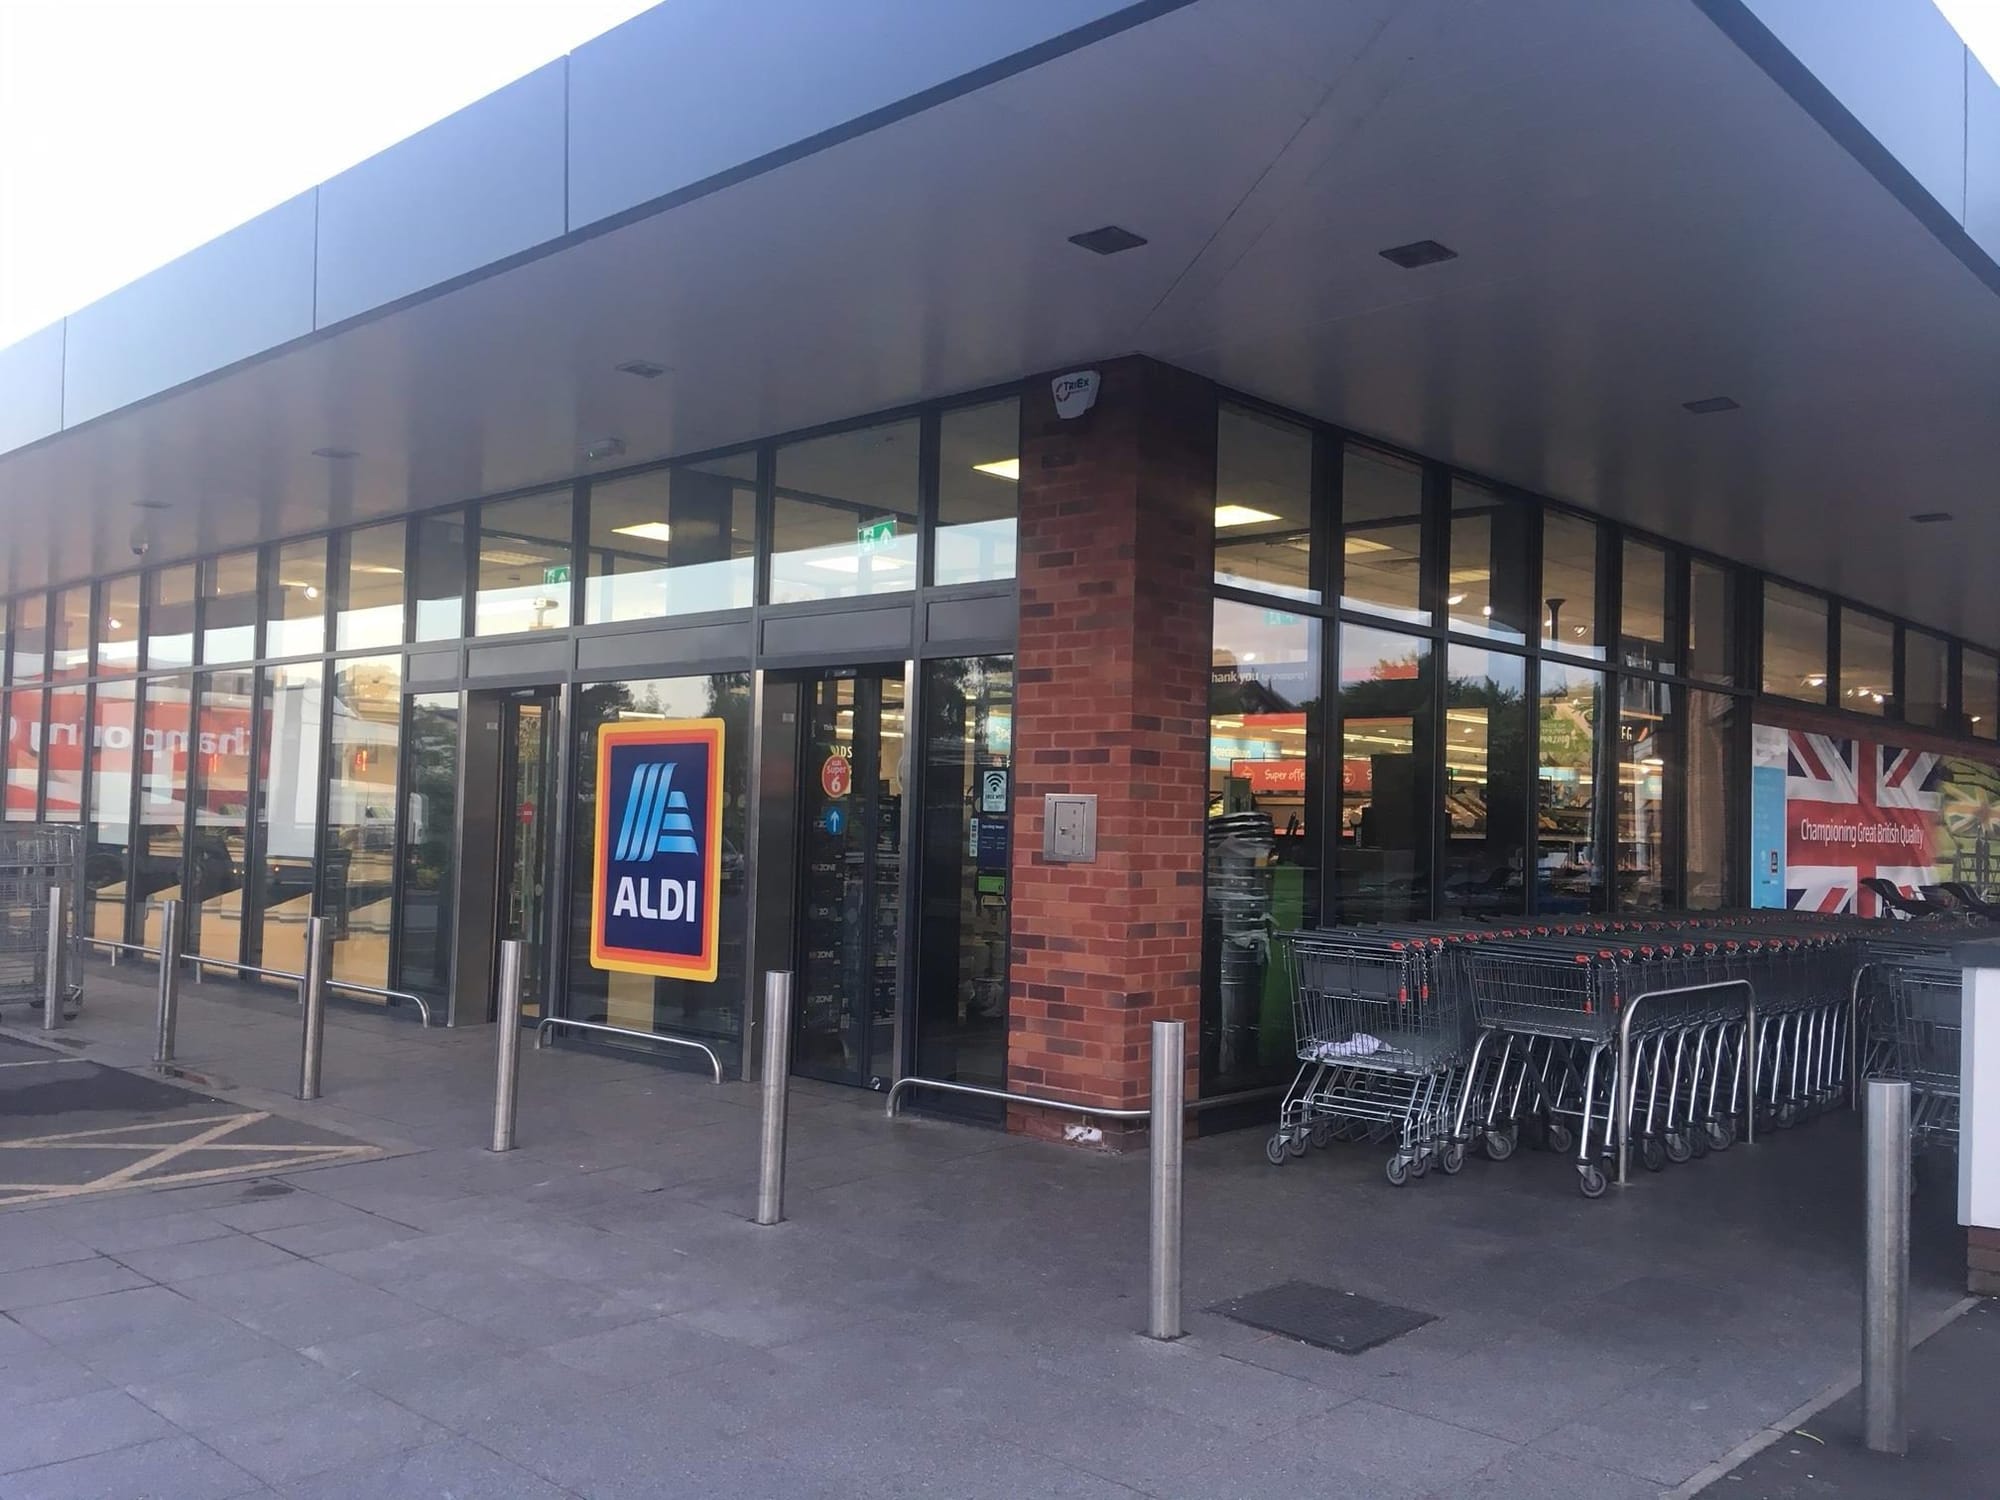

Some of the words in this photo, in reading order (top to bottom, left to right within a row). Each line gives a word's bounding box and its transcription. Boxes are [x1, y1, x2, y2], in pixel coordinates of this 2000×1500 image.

[1211, 671, 1237, 684] hank
[1238, 672, 1258, 685] you
[1264, 768, 1287, 783] Super
[1288, 767, 1305, 783] offe
[831, 776, 841, 792] 6
[1801, 818, 1857, 848] Championing
[1857, 822, 1877, 843] Great
[1877, 822, 1900, 844] British
[1900, 823, 1924, 850] Quality
[612, 876, 696, 922] ALDI
